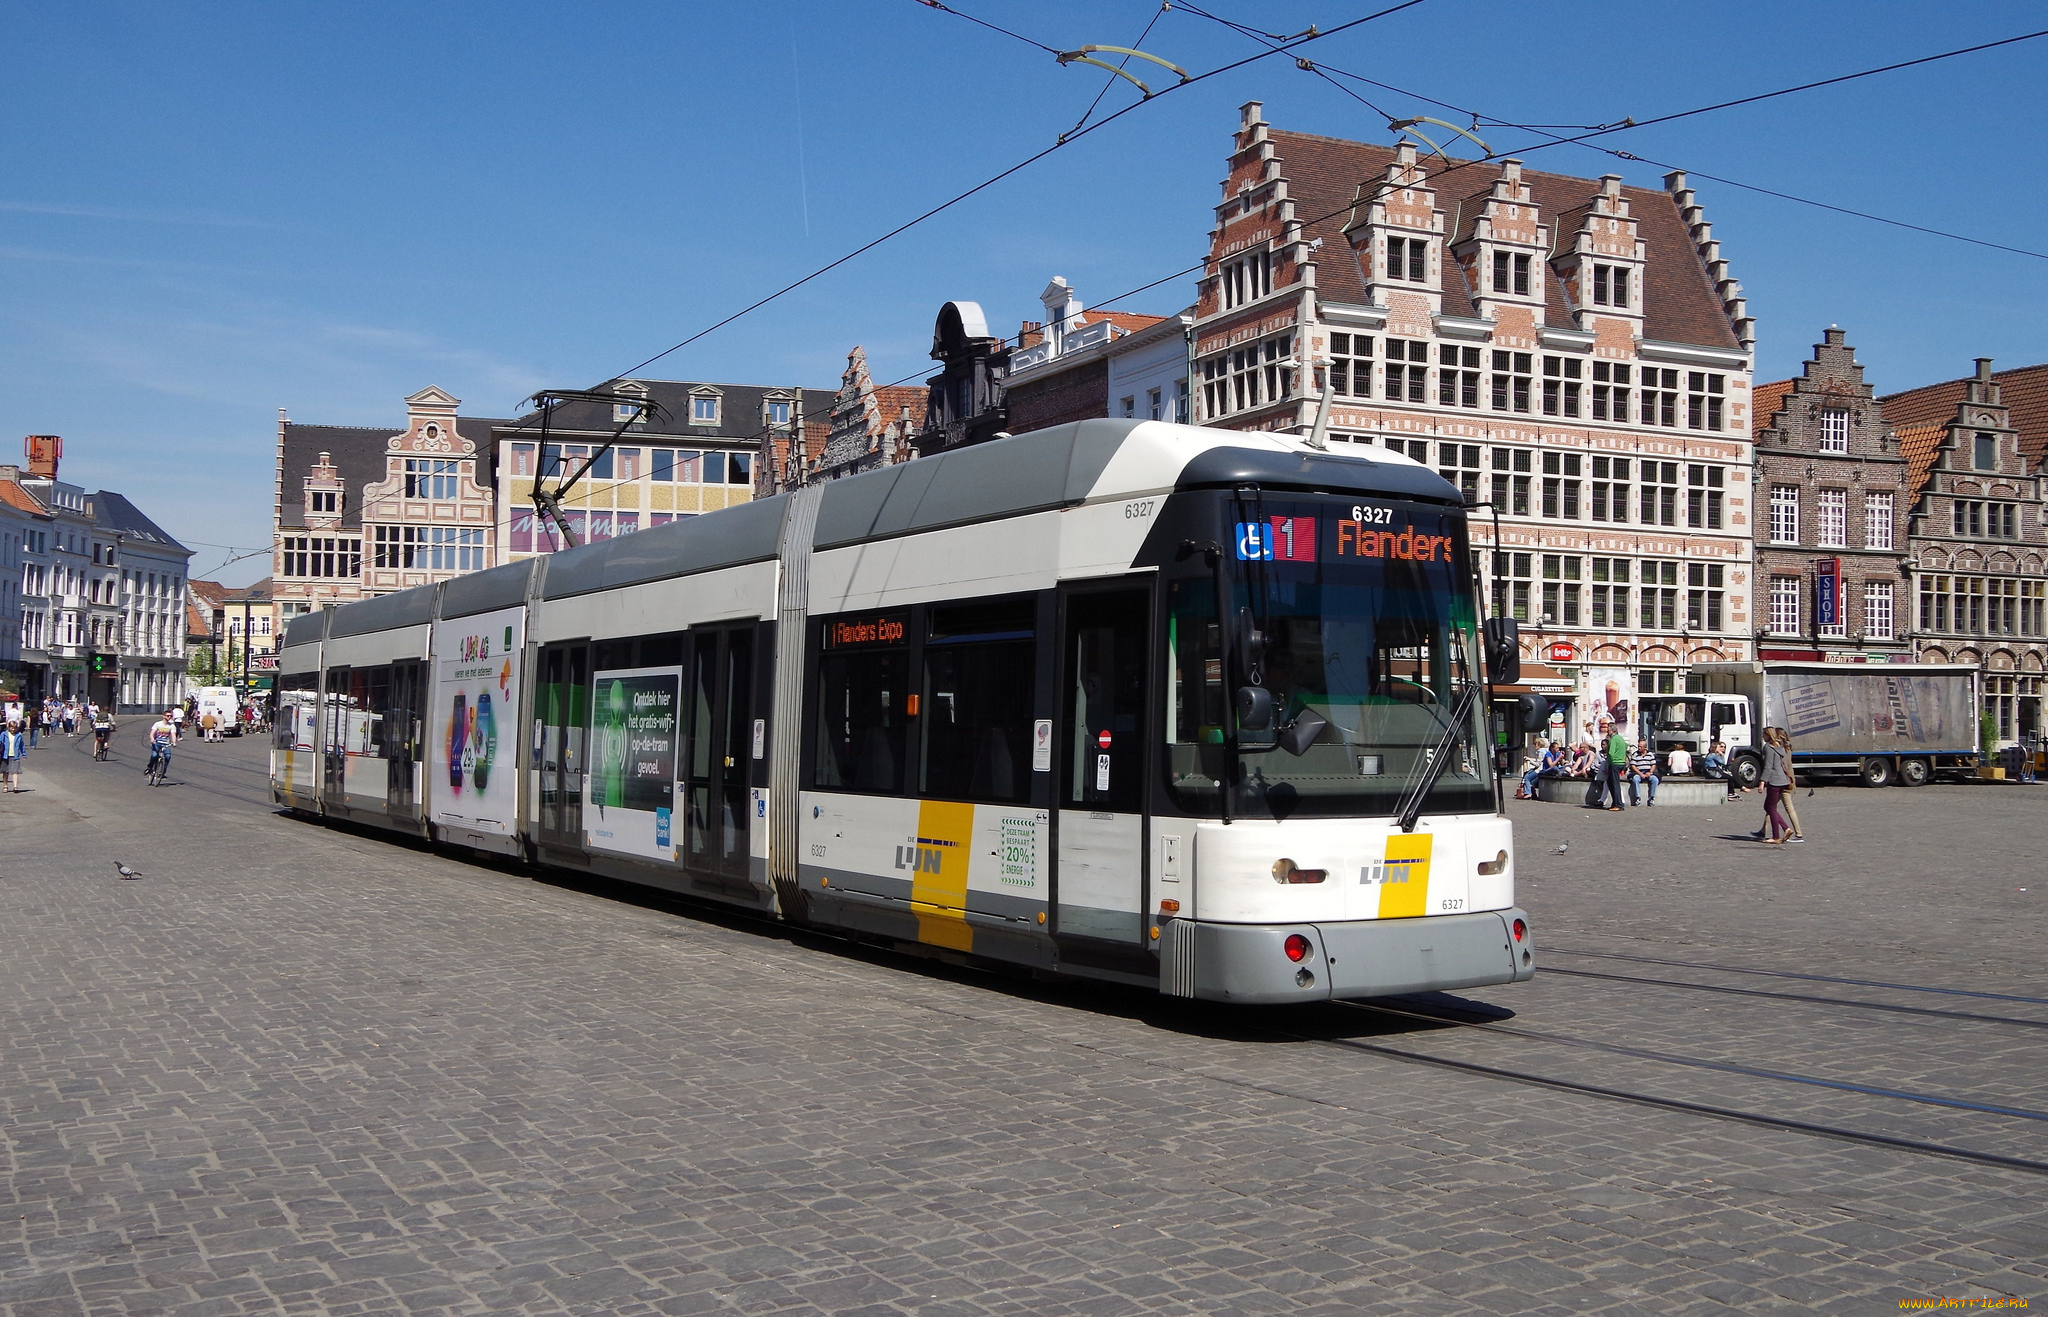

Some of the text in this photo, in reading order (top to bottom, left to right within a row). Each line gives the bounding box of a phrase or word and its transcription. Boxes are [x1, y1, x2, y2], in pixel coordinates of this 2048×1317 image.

[1125, 501, 1155, 519] 6327
[1352, 505, 1393, 524] 6327
[1281, 518, 1452, 563] 1 Flanders
[1823, 577, 1832, 622] SHOP
[838, 621, 876, 643] Flanders
[879, 618, 903, 644] Expo
[634, 690, 671, 707] Ontdek hier
[1885, 677, 1911, 741] Jupiler
[628, 713, 674, 733] het gratis-wifi-
[632, 735, 669, 754] op-de-tram
[637, 759, 660, 778] gevoel.
[1006, 837, 1030, 845] BESPAART
[811, 844, 827, 858] 6327
[895, 845, 942, 875] LIJN
[1006, 846, 1030, 864] 20%
[1006, 864, 1023, 876] ENERGIE
[1360, 865, 1410, 885] LIJN
[1442, 899, 1464, 910] 6327
